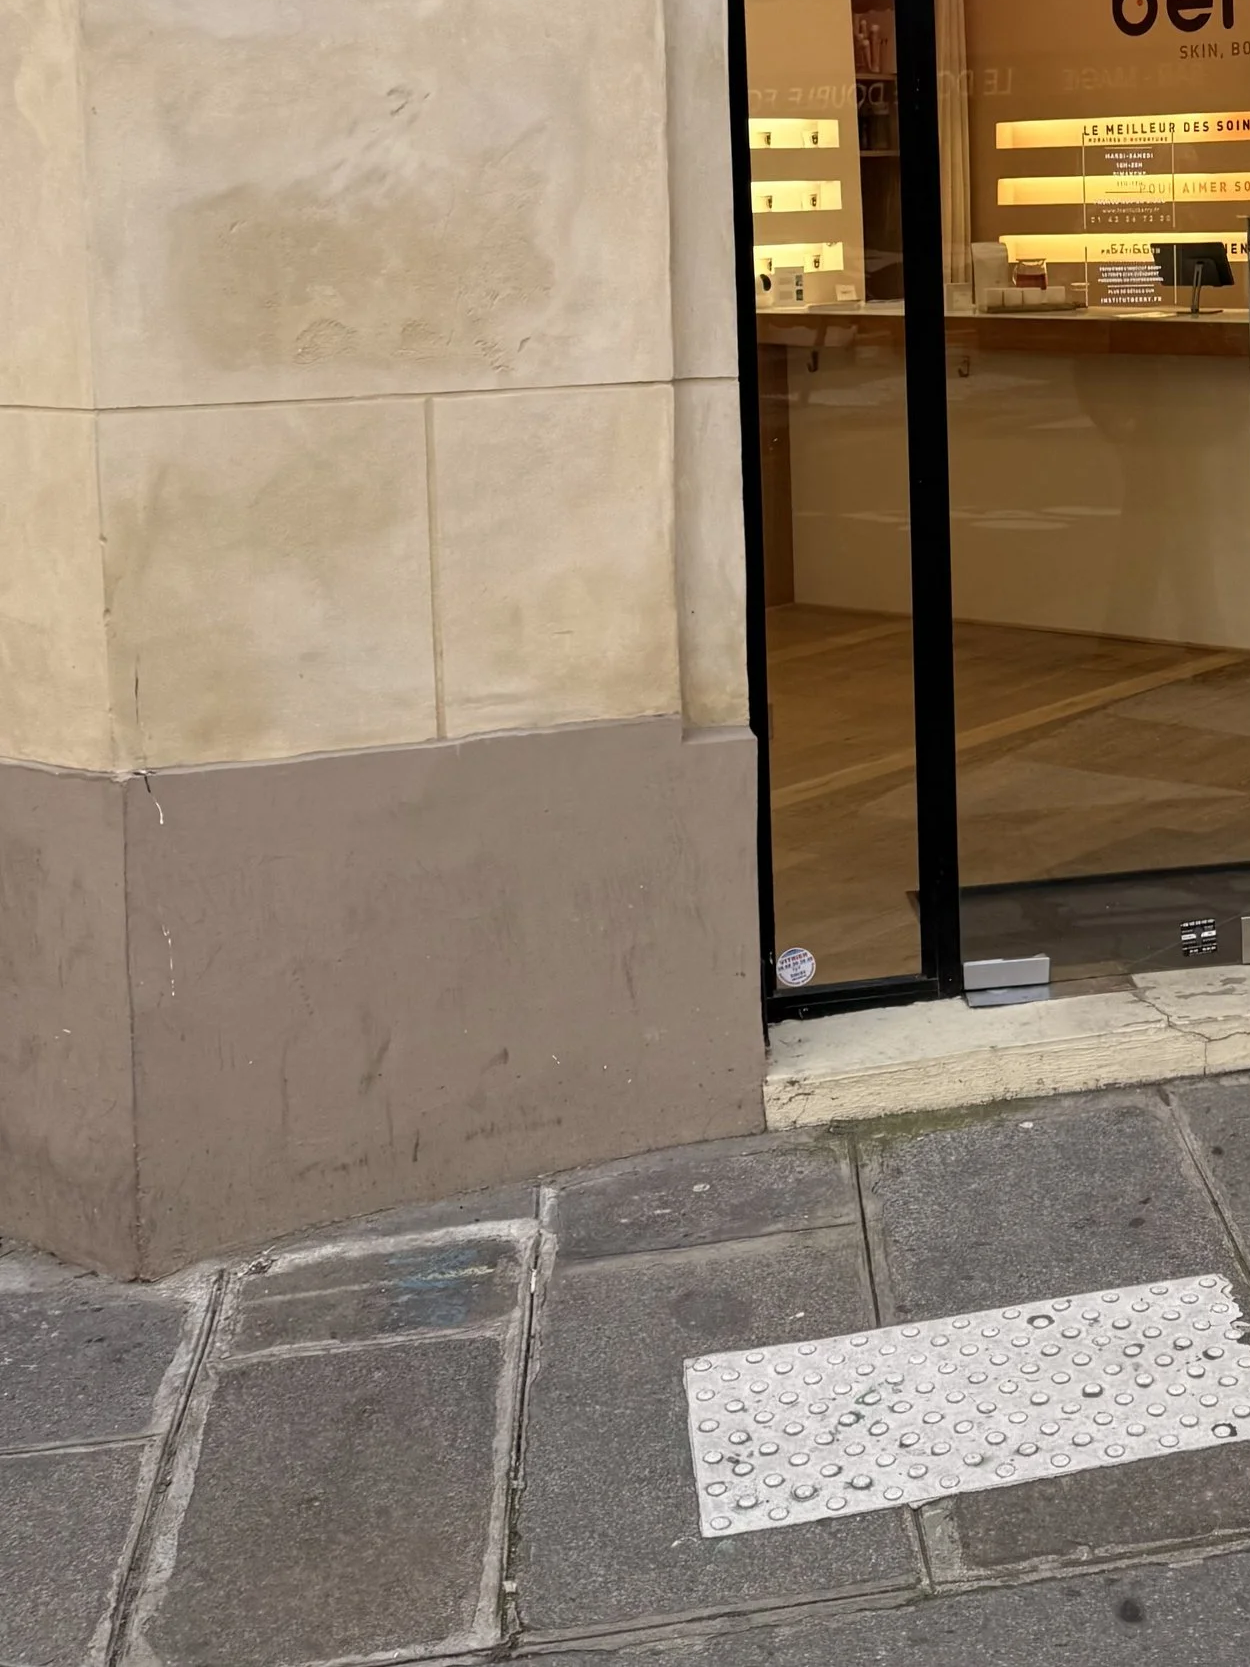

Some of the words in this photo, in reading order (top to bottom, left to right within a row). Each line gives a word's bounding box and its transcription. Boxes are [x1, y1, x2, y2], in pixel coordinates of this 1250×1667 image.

[1179, 42, 1224, 60] SKIN,
[1083, 125, 1099, 136] LE
[1106, 122, 1175, 135] MEILLEUR
[1183, 121, 1210, 133] DES
[1183, 182, 1227, 194] AIMER
